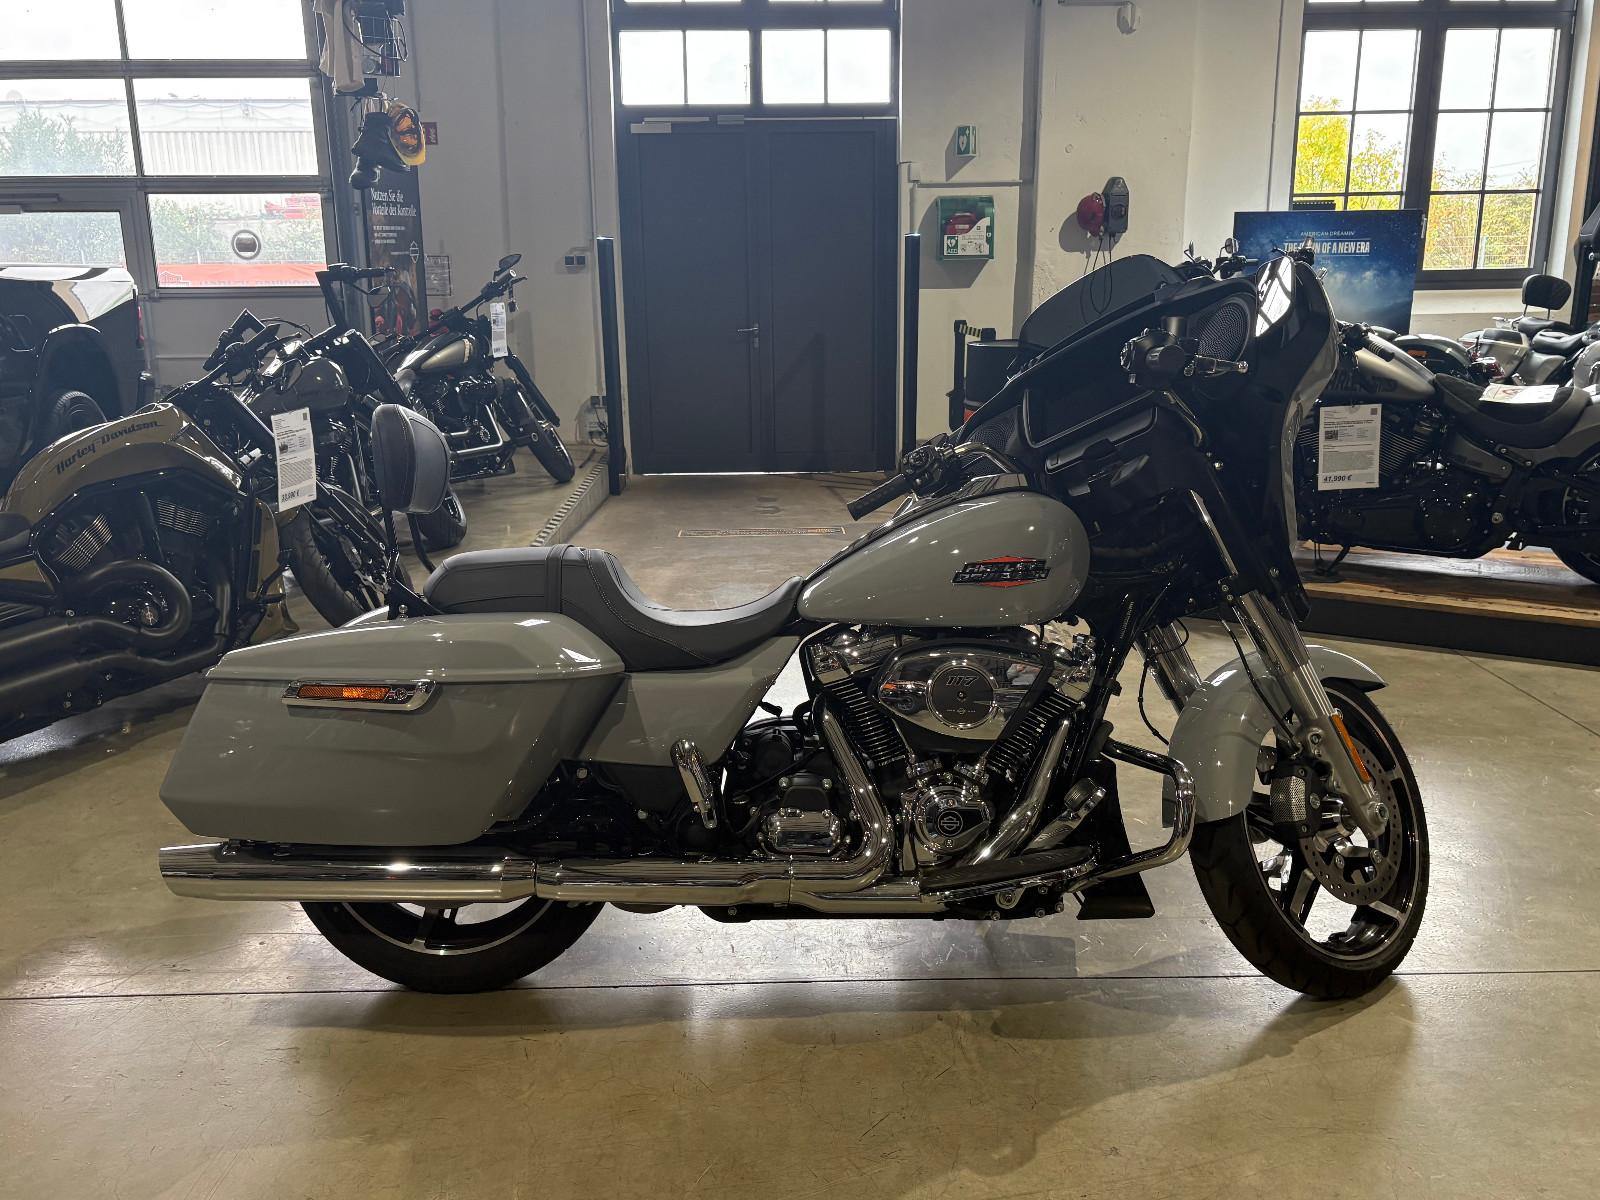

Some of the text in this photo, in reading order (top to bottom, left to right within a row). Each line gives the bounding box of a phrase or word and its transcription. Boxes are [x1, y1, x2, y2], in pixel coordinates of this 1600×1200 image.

[1284, 241, 1298, 253] THE
[1321, 241, 1332, 254] OF
[1332, 241, 1337, 254] A
[1338, 241, 1356, 254] NEW
[1356, 241, 1370, 253] ERA
[54, 420, 162, 475] Harley-Davidson
[946, 675, 980, 687] 117
